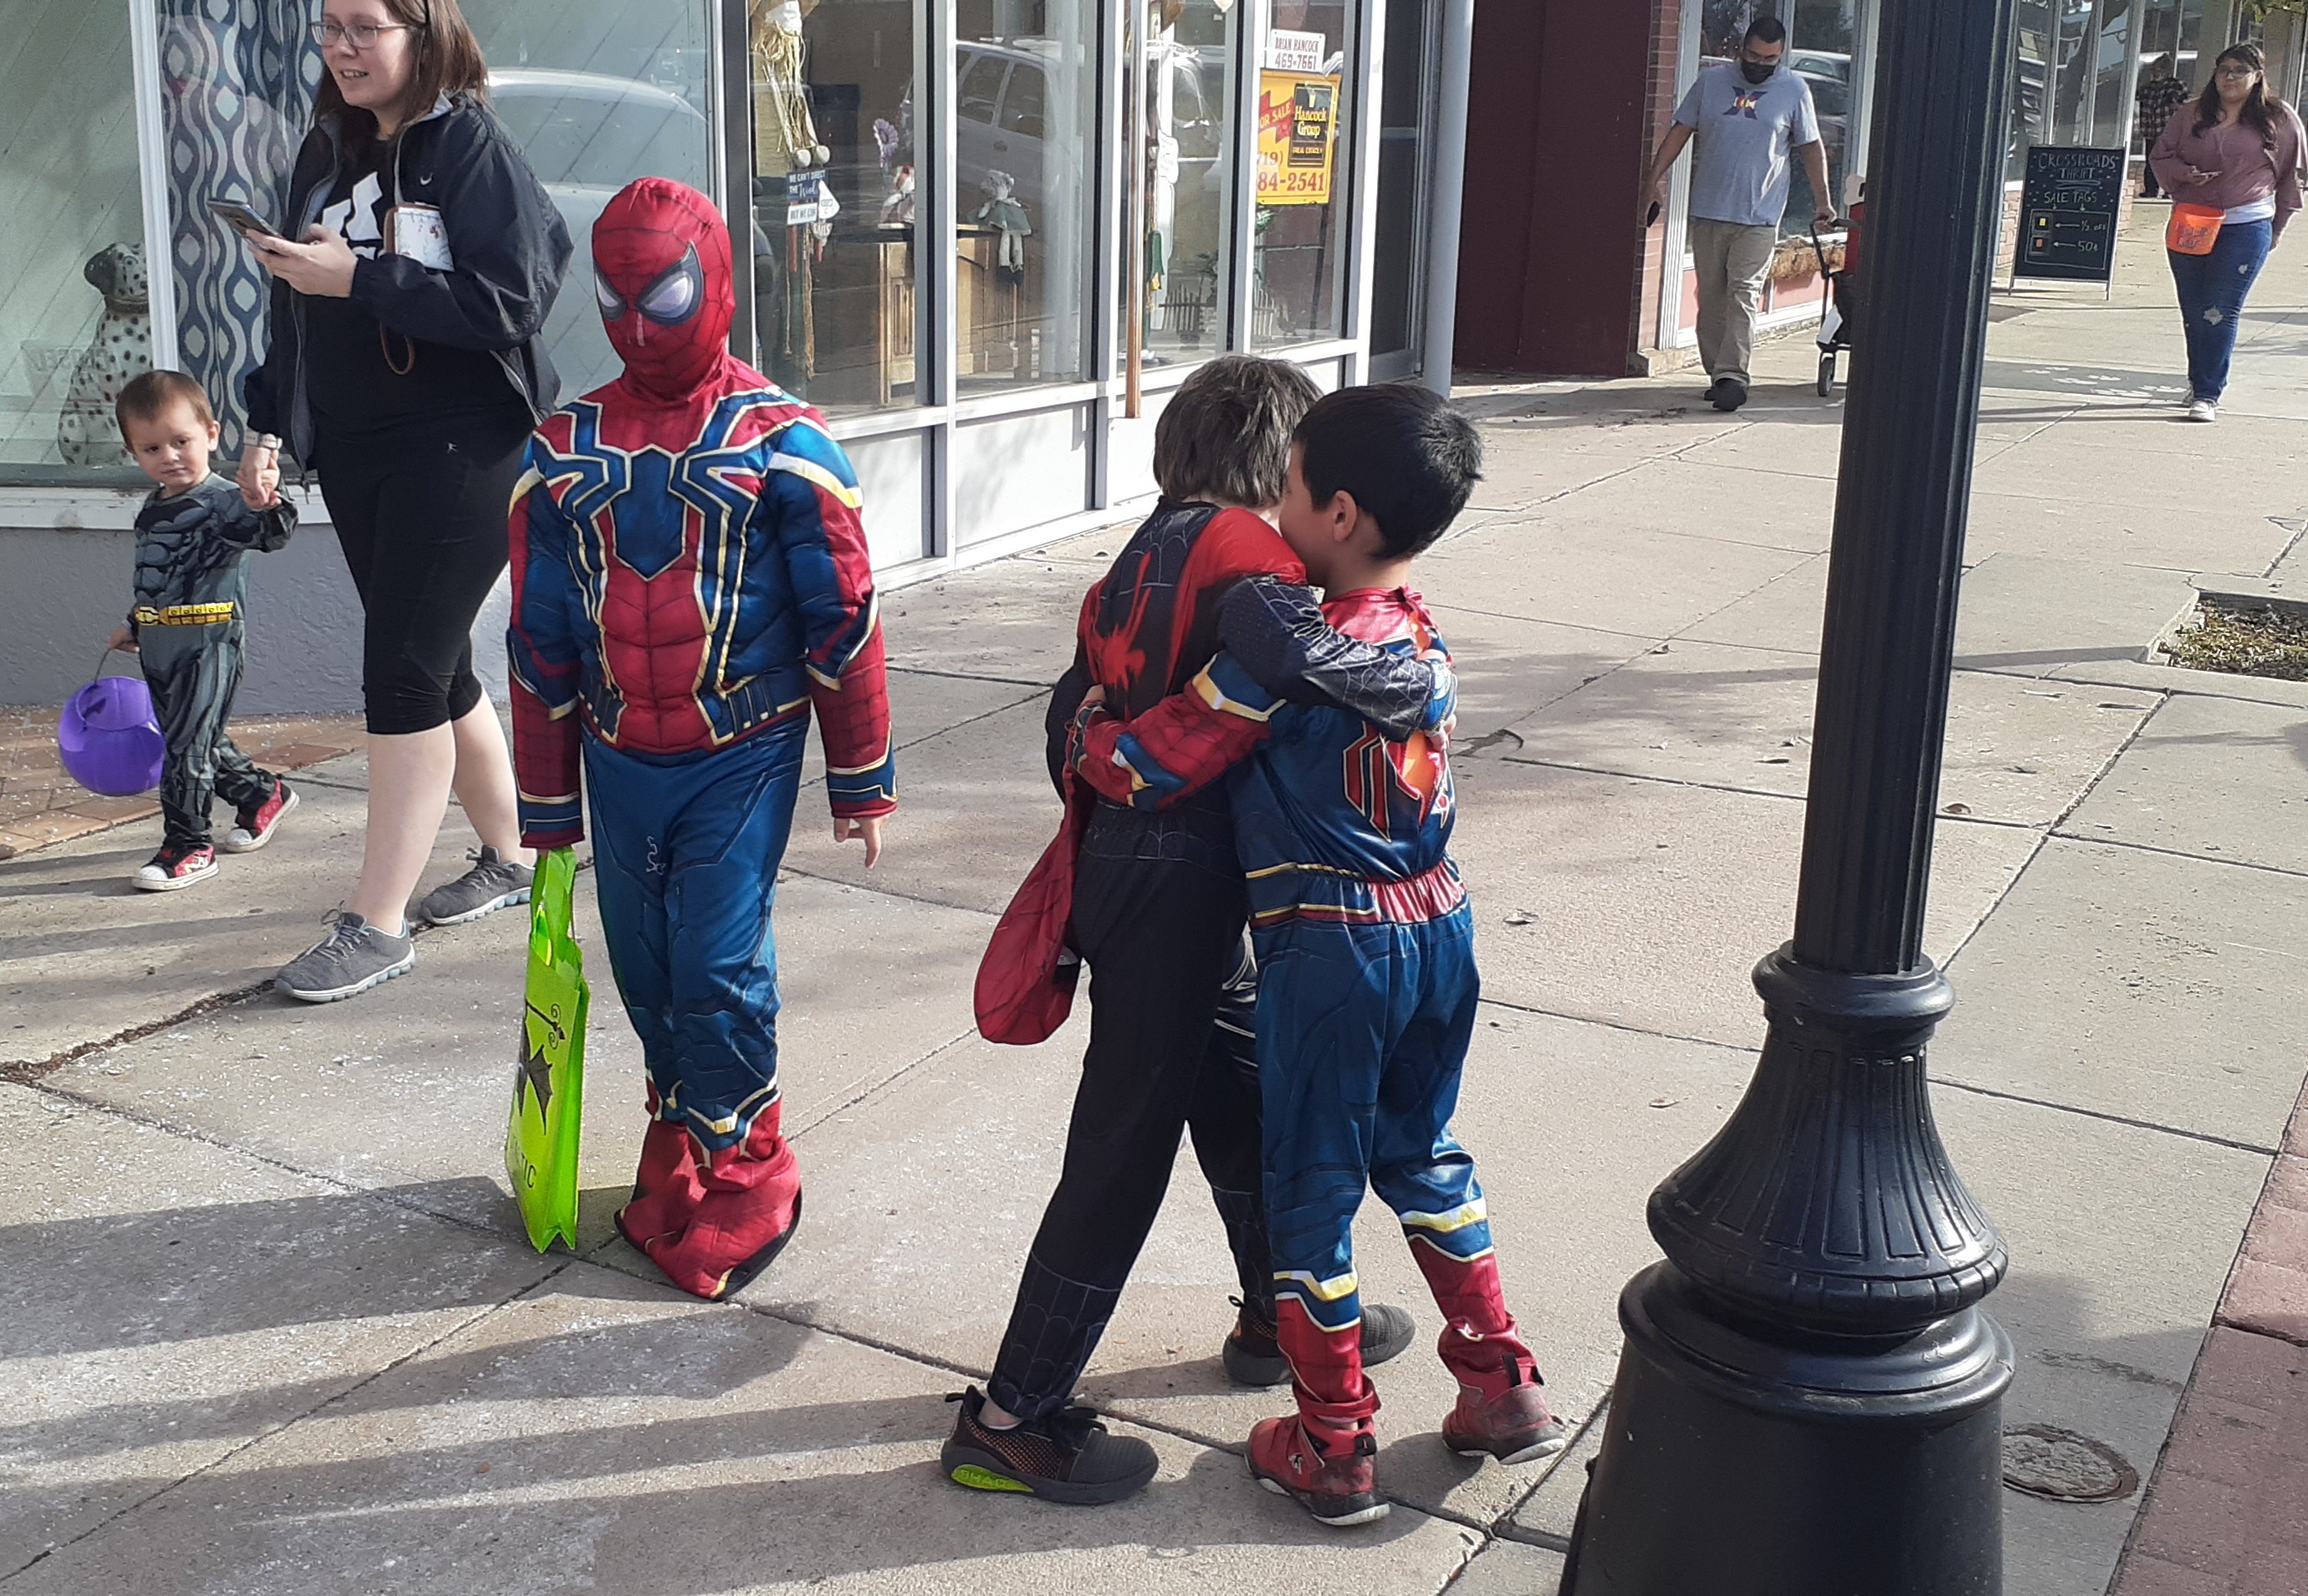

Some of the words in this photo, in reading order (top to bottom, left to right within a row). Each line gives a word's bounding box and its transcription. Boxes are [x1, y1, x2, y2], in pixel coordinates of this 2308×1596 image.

[1275, 37, 1292, 50] BRIAN
[1293, 38, 1319, 53] HANCOCK
[1274, 53, 1317, 70] 469-7661
[1259, 115, 1270, 128] OR
[1272, 101, 1292, 123] SALE
[1294, 105, 1327, 121] Hancock
[1297, 120, 1321, 139] Group
[1257, 151, 1283, 166] 719)
[2039, 153, 2116, 169] CROSSROADS
[1257, 171, 1324, 192] 84-2541
[2059, 167, 2096, 180] THRIFT
[2044, 191, 2069, 203] SALE
[2072, 190, 2097, 203] TAGS
